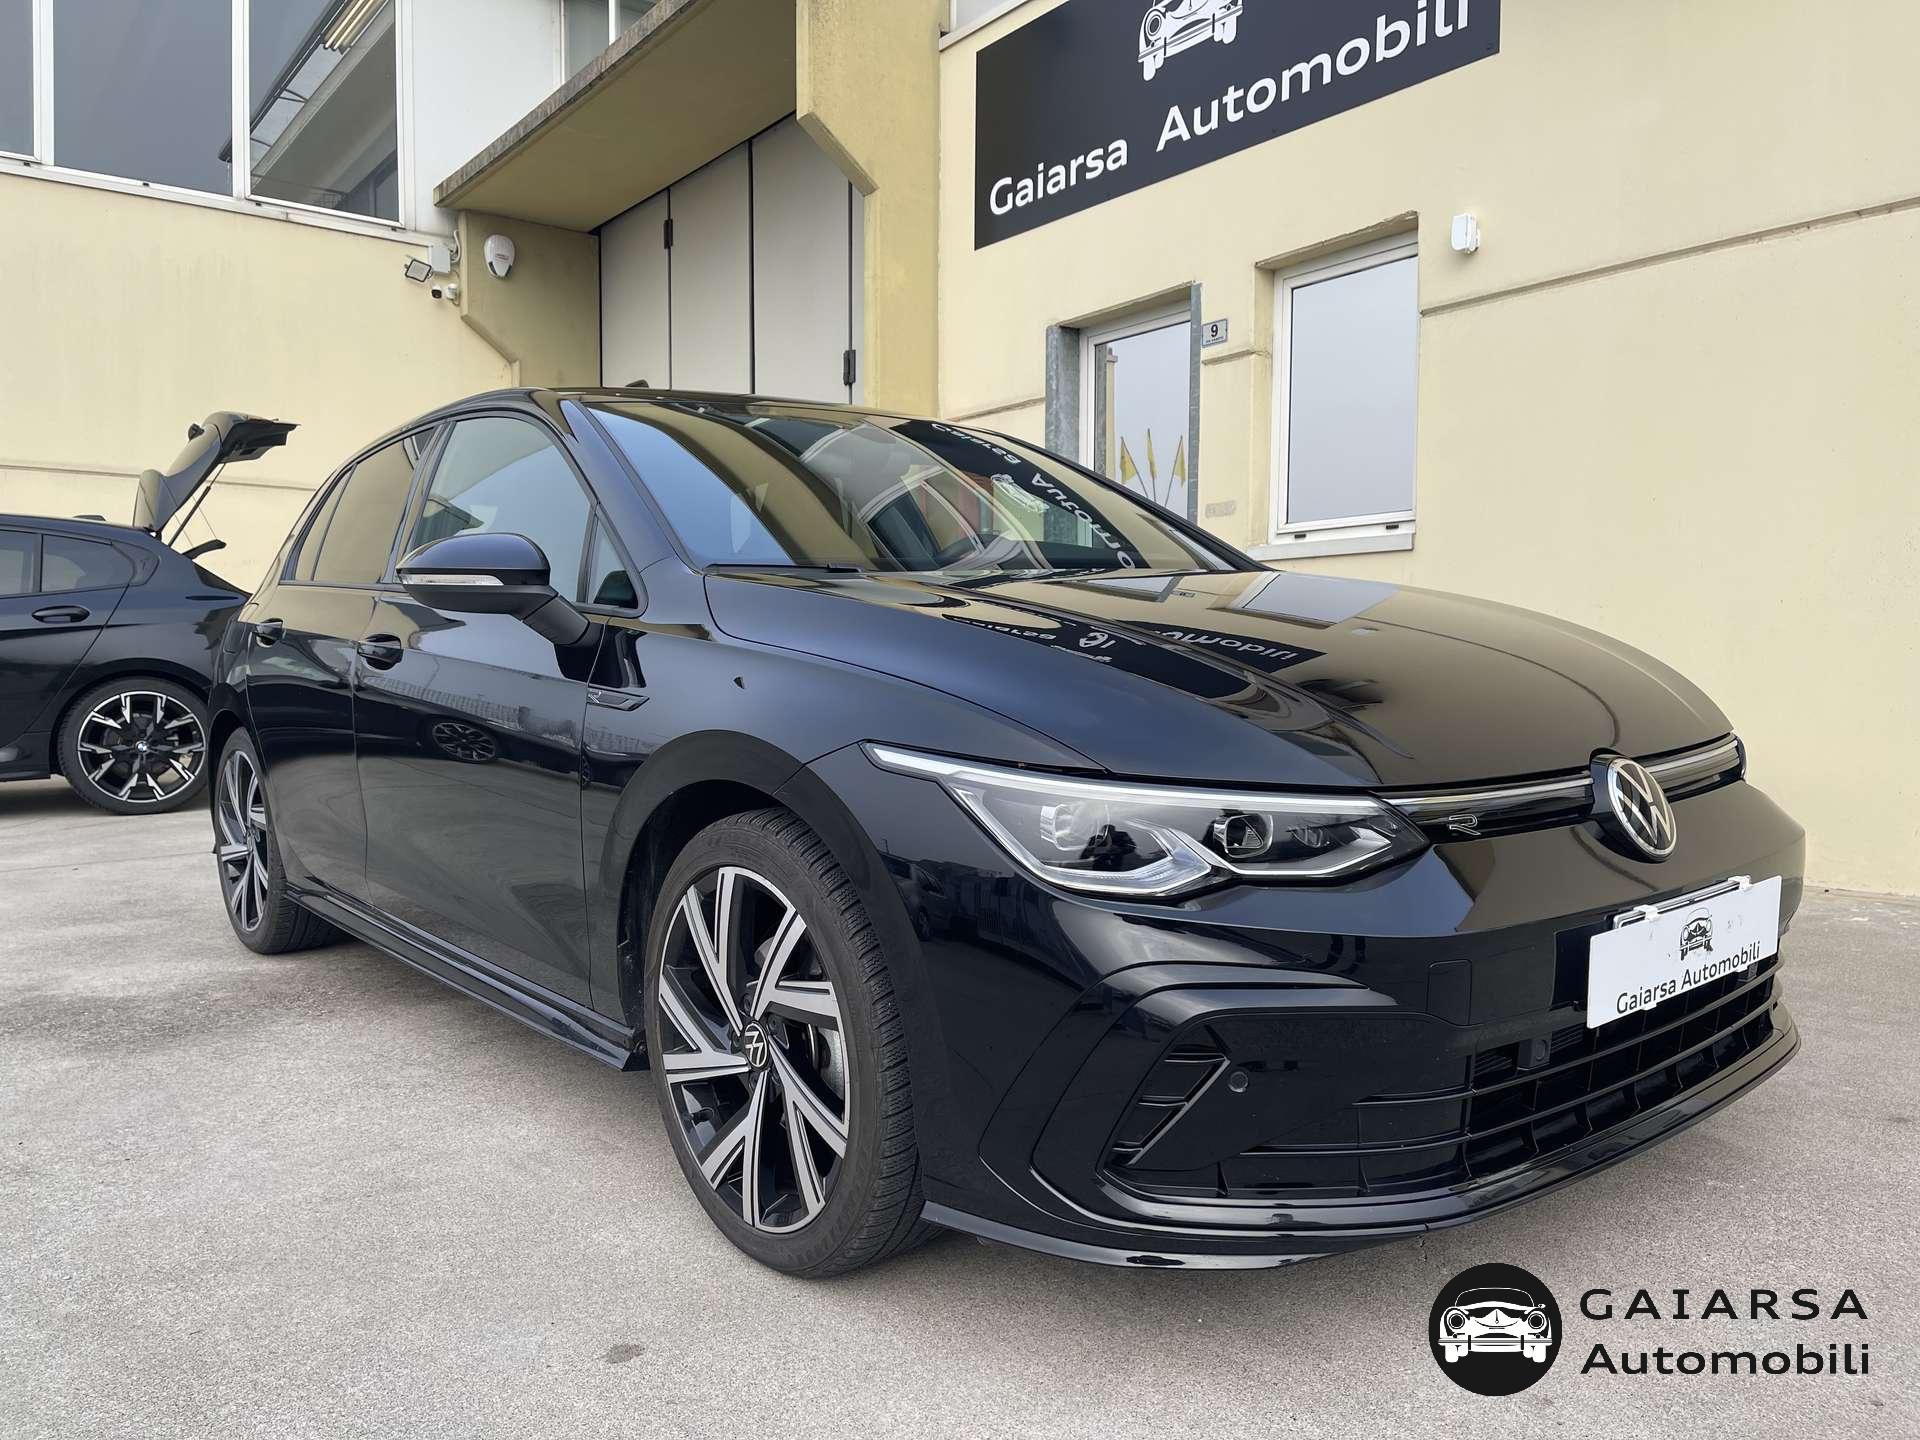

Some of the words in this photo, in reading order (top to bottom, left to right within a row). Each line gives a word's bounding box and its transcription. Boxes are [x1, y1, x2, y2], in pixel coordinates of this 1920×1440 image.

[990, 139, 1127, 215] Gaiarsa
[1156, 0, 1469, 152] Automobili
[1211, 324, 1219, 337] 9
[1616, 979, 1676, 1014] Gaiarsa
[1681, 941, 1760, 990] Automobili
